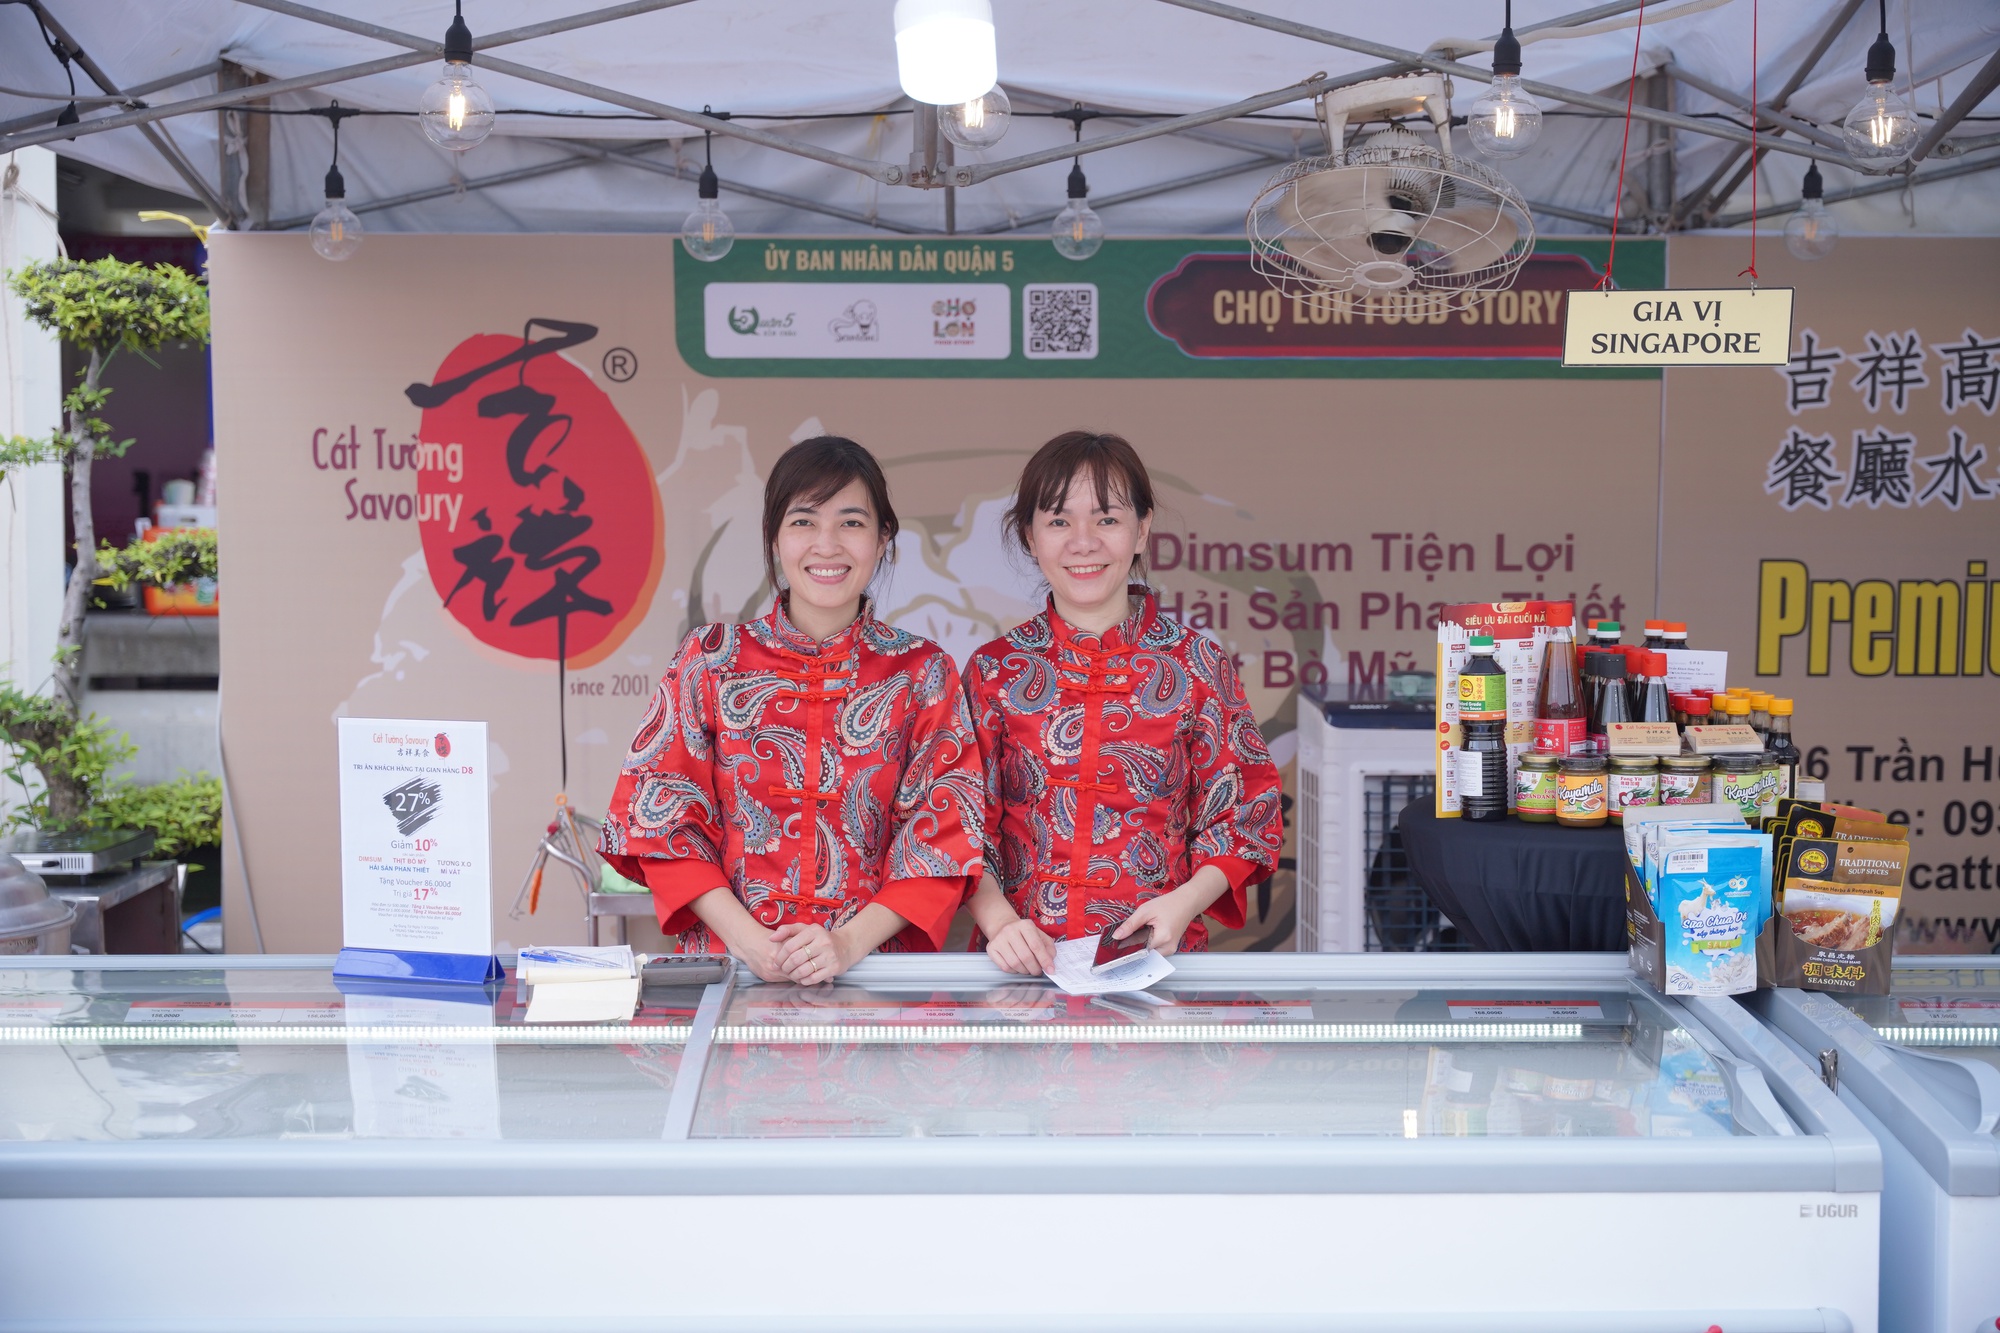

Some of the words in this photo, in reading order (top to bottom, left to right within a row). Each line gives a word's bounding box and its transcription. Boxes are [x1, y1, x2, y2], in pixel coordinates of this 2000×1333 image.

[765, 243, 789, 271] ỦY
[796, 250, 836, 271] BAN
[841, 244, 893, 271] NHÂN
[900, 244, 939, 271] DÂN
[944, 244, 996, 276] QUẬN
[1002, 250, 1014, 271] 5
[1213, 286, 1281, 332] CHỢ
[1365, 290, 1450, 325] FOOD
[1460, 290, 1562, 325] STORY
[1633, 300, 1693, 323] GIA
[1697, 300, 1723, 329] VỊ
[1591, 331, 1761, 355] SINGAPORE
[313, 425, 360, 470] Cát
[373, 428, 463, 483] Tường
[1768, 429, 2000, 509] 餐廳水
[345, 478, 463, 533] Savoury
[1150, 532, 1353, 572] Dimsum
[1371, 532, 1474, 582] Tiện
[1495, 533, 1574, 582] Lợi
[1153, 590, 1228, 630] Hải
[1248, 590, 1339, 630] Sản
[1465, 615, 1482, 626] SIÊU
[1513, 610, 1532, 624] CUỐI
[1535, 610, 1547, 624] NĂ
[1263, 650, 1328, 690] Bò
[570, 676, 604, 696] since
[611, 675, 650, 696] 2001
[373, 733, 383, 743] Cát
[405, 734, 429, 747] Savoury
[461, 766, 474, 774] D8
[1846, 737, 1944, 782] Trần
[1963, 745, 2000, 782] H
[395, 792, 431, 812] 27%
[1558, 778, 1603, 805] Kayamila
[391, 839, 414, 849] Giảm
[414, 838, 438, 851] 10%
[1839, 858, 1901, 869] TRADITIONAL
[396, 878, 422, 886] Voucher
[1802, 883, 1829, 892] Campuran
[413, 887, 438, 900] 17%
[1706, 915, 1733, 928] Chua
[1707, 941, 1732, 950] SALA
[1807, 977, 1856, 987] SEASONING
